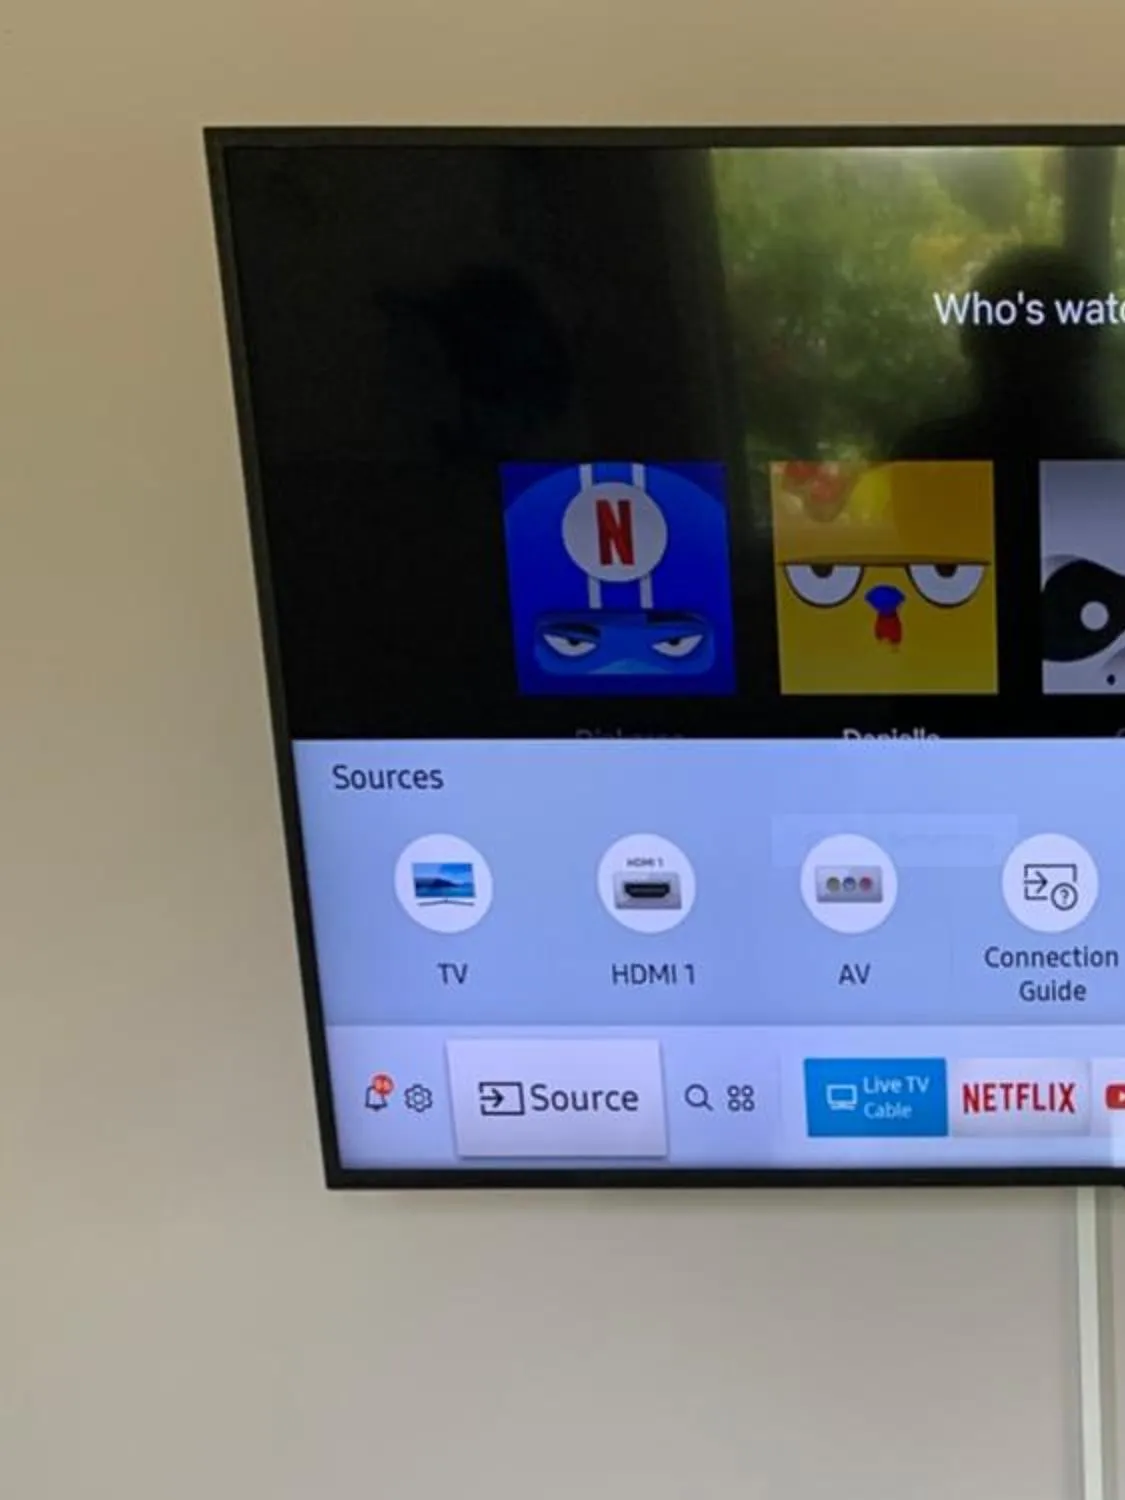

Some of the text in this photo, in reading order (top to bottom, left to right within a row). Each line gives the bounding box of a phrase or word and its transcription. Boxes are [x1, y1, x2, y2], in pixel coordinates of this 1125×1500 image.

[933, 292, 1046, 326] Who's
[595, 499, 635, 567] N
[332, 764, 445, 791] Sources
[983, 945, 1120, 969] Connection
[437, 962, 469, 986] TV
[611, 962, 696, 986] HDMI 1
[838, 963, 872, 986] AV
[1018, 980, 1088, 1003] Guide
[862, 1076, 931, 1095] Live TV
[529, 1083, 640, 1113] Source
[961, 1082, 1076, 1115] NETFLIX
[863, 1101, 913, 1120] Cable
